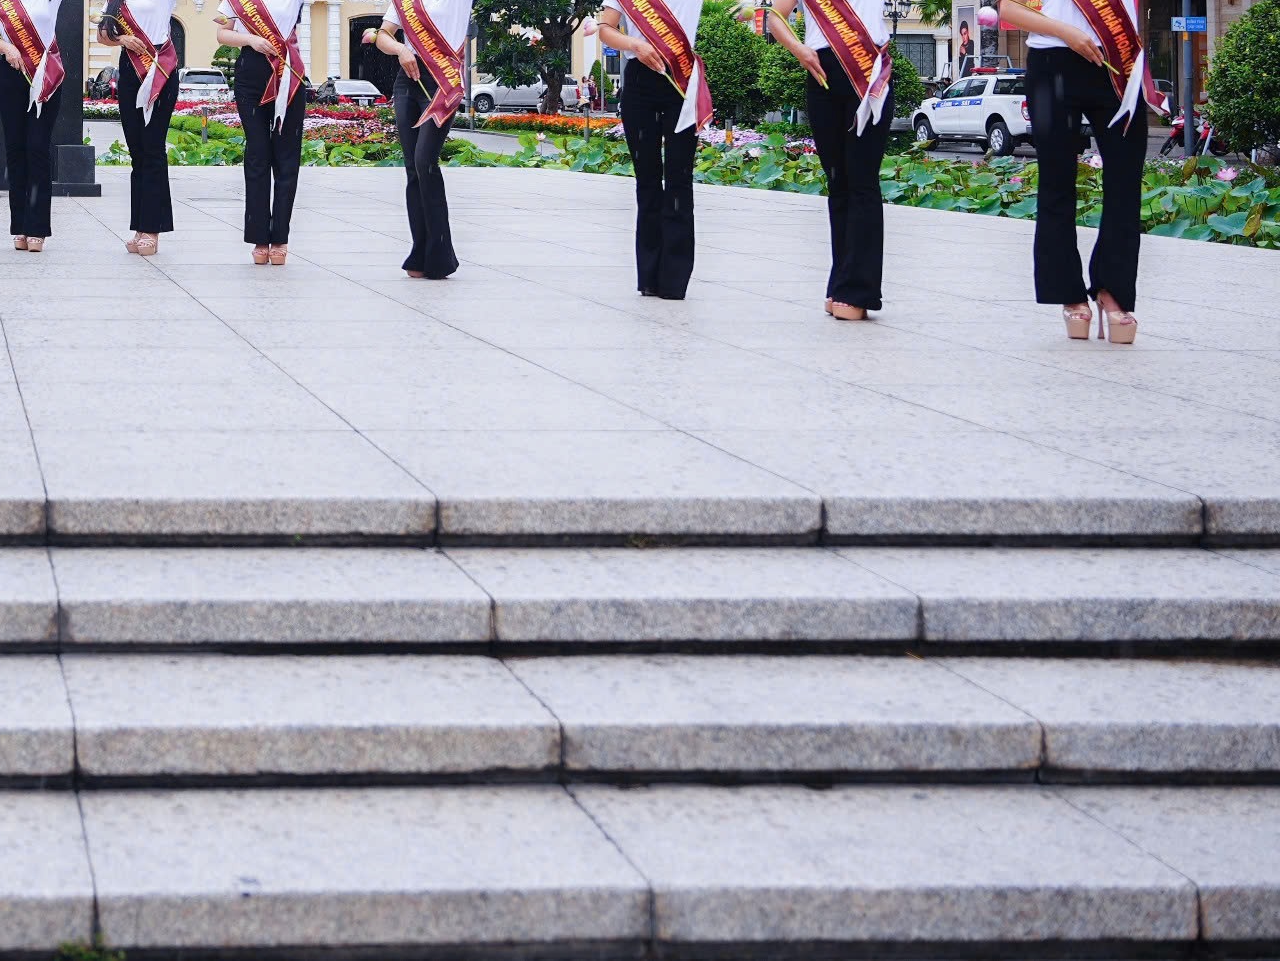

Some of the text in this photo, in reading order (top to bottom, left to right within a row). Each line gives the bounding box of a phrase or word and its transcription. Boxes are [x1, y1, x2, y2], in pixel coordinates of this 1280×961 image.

[6, 9, 24, 31] DOANH
[17, 28, 34, 48] NHÂN
[252, 14, 272, 38] DOANH
[404, 9, 424, 34] DOANH
[418, 29, 437, 51] NHÂN
[429, 47, 451, 69] HOÀN
[642, 8, 669, 37] DOANH
[661, 31, 684, 56] NHÂN
[834, 21, 860, 47] NHÂN
[849, 43, 873, 70] HOÀN
[1098, 5, 1124, 35] NHÂN
[1114, 32, 1133, 64] HOÀN
